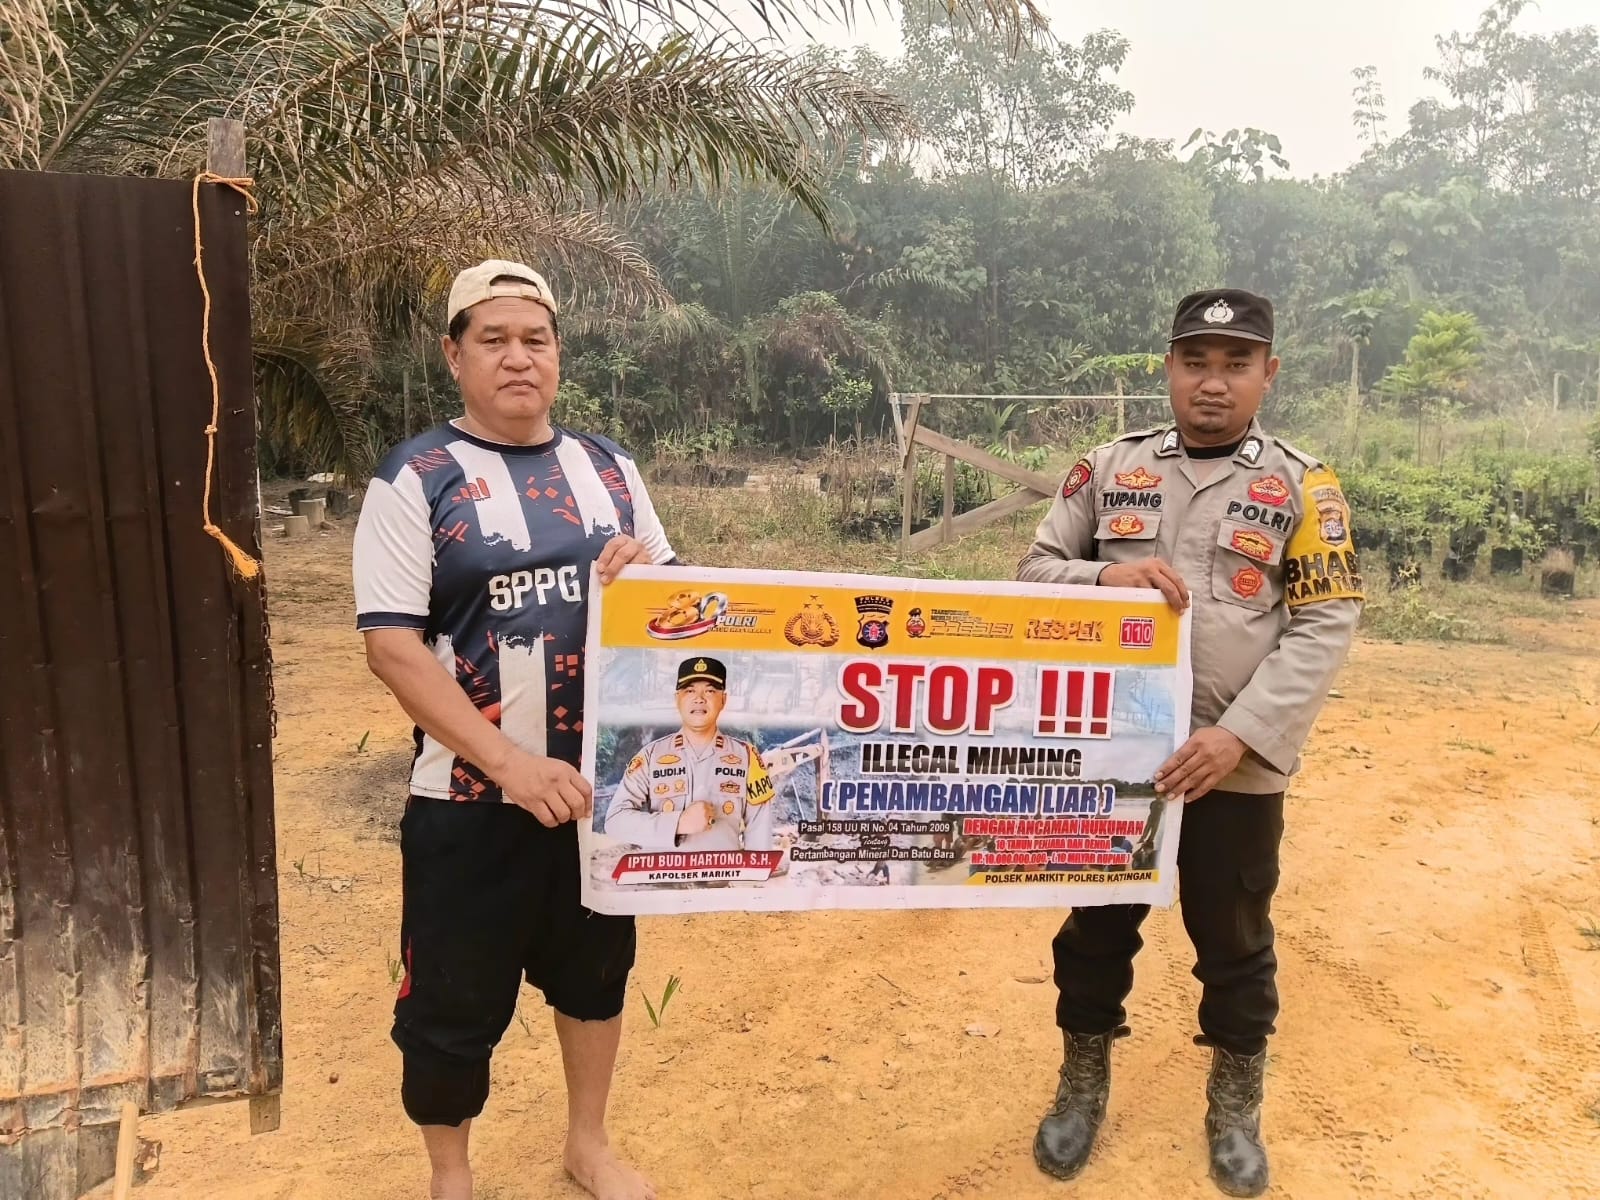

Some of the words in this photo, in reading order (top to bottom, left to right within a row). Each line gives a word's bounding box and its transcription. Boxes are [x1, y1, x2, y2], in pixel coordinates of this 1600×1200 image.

[1103, 491, 1162, 508] TUPANG
[1226, 500, 1292, 532] POLRI
[488, 565, 582, 611] SPPG
[716, 615, 757, 627] POLRI
[1024, 619, 1103, 641] RESPEK
[1122, 622, 1151, 643] 110
[840, 661, 1014, 733] STOP
[1038, 670, 1111, 735] !!!
[862, 743, 960, 774] ILLEGAL
[967, 746, 1082, 777] MINNING
[653, 767, 686, 778] BUDI.H
[715, 767, 745, 778] POLRI
[800, 822, 824, 832] Pasal
[828, 822, 842, 832] 158
[844, 822, 858, 832] UU
[860, 822, 870, 832] RI
[872, 823, 887, 833] No.
[888, 823, 898, 832] 04
[901, 823, 928, 832] Tahun
[929, 823, 950, 833] 2009
[963, 819, 1014, 835] DENGAN
[1017, 819, 1078, 835] ANCAMAN
[1081, 820, 1145, 836] HUKUMAN
[861, 836, 889, 846] Tentang
[1007, 839, 1032, 850] TAHUN
[1067, 839, 1083, 850] DAN
[1085, 839, 1111, 850] DENDA
[627, 855, 655, 869] IPTU
[658, 854, 686, 868] BUDI
[689, 852, 747, 868] HARTONO,
[750, 853, 772, 866] S.H.
[792, 849, 856, 861] Pertambangan
[858, 849, 890, 860] Mineral
[891, 849, 909, 859] Dan
[911, 849, 932, 859] Batu
[933, 849, 955, 859] Bara
[648, 871, 699, 880] KAPOLSEK
[701, 870, 742, 879] MARIKIT
[985, 873, 1022, 884] POLSEK
[1025, 873, 1064, 883] MARIKIT
[1067, 873, 1105, 883] POLRES
[1106, 871, 1152, 883] KATINGAN
